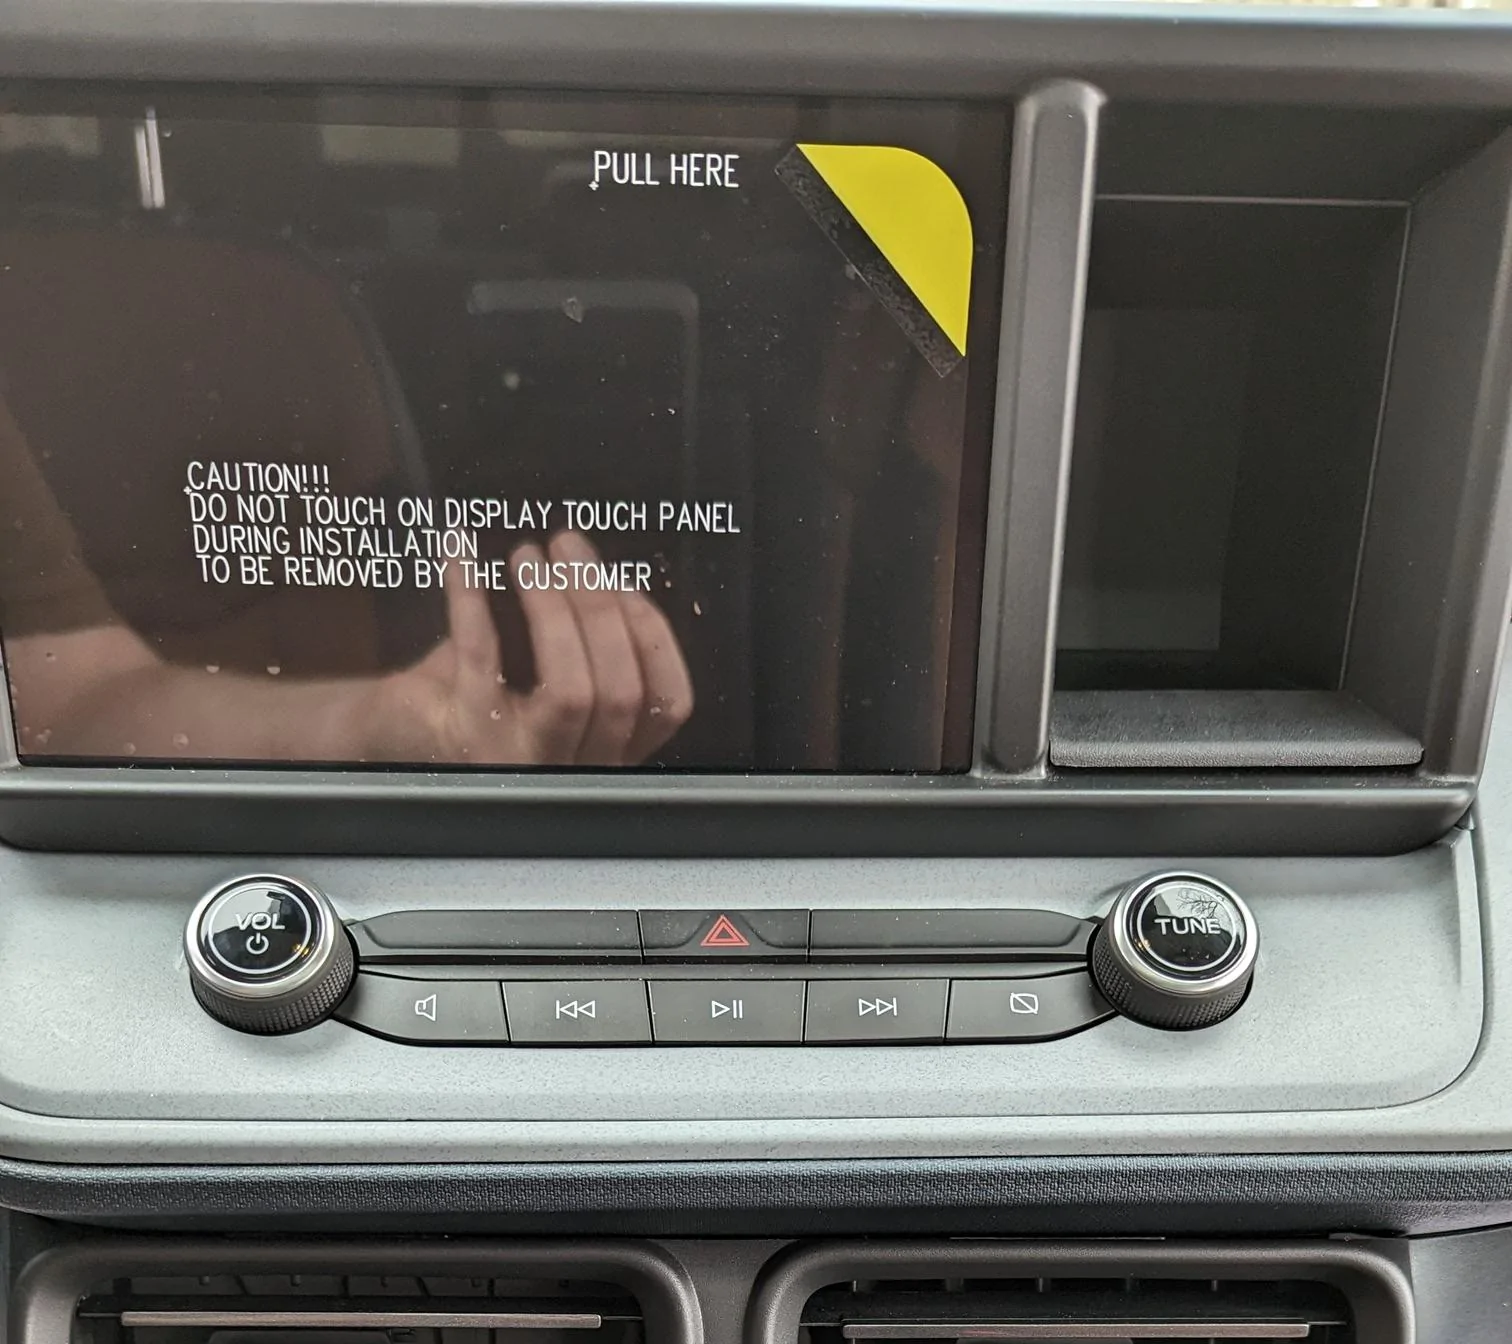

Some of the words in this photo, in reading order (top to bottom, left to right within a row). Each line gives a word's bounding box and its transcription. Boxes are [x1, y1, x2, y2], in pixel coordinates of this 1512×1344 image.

[594, 150, 660, 186] PULL
[670, 153, 740, 188] HERE
[187, 461, 330, 493] CAUTION!!!
[189, 493, 228, 523] DO
[237, 494, 289, 524] NOT
[300, 495, 386, 527] TOUCH
[398, 496, 433, 529] ON
[445, 498, 552, 530] DISPLAY
[562, 500, 647, 531] TOUCH
[658, 502, 741, 533] PANEL
[193, 524, 290, 555] DURING
[300, 526, 478, 559] INSTALLATION
[196, 554, 230, 584] TO
[240, 555, 274, 586] BE
[284, 556, 403, 589] REMOVED
[414, 560, 449, 589] BY
[459, 561, 507, 591] THE
[518, 561, 652, 592] CUSTOMER
[235, 911, 286, 931] VOL
[1154, 918, 1221, 935] TUNE
